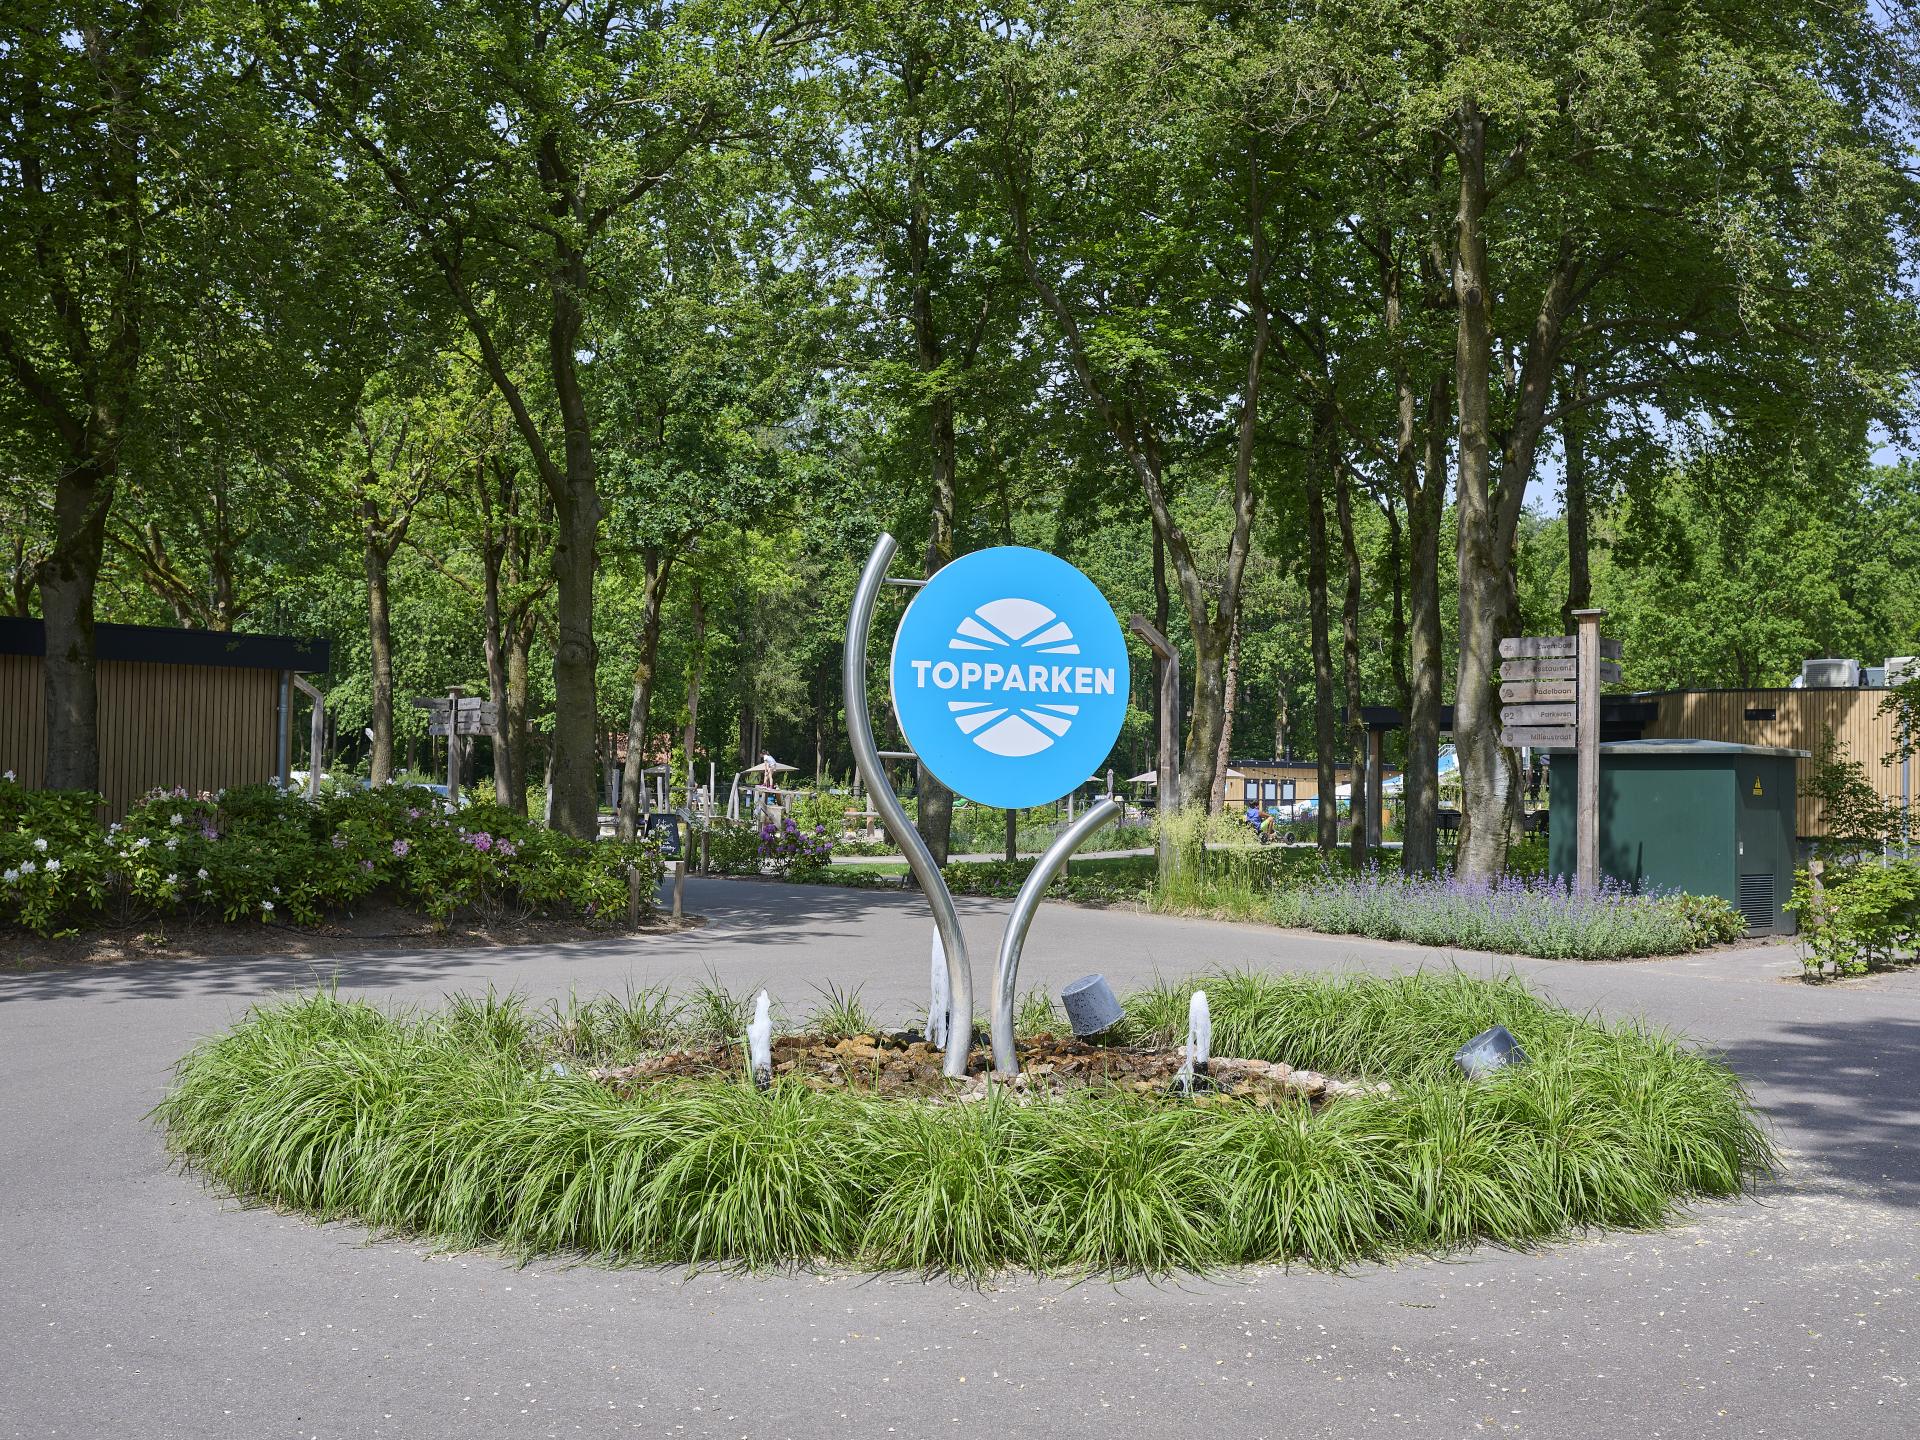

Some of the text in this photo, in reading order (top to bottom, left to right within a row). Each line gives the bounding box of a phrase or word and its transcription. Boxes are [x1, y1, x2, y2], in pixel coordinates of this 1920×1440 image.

[1536, 642, 1572, 650] Zwembad
[911, 660, 1115, 695] TOPPARKEN
[1504, 712, 1514, 720] P2
